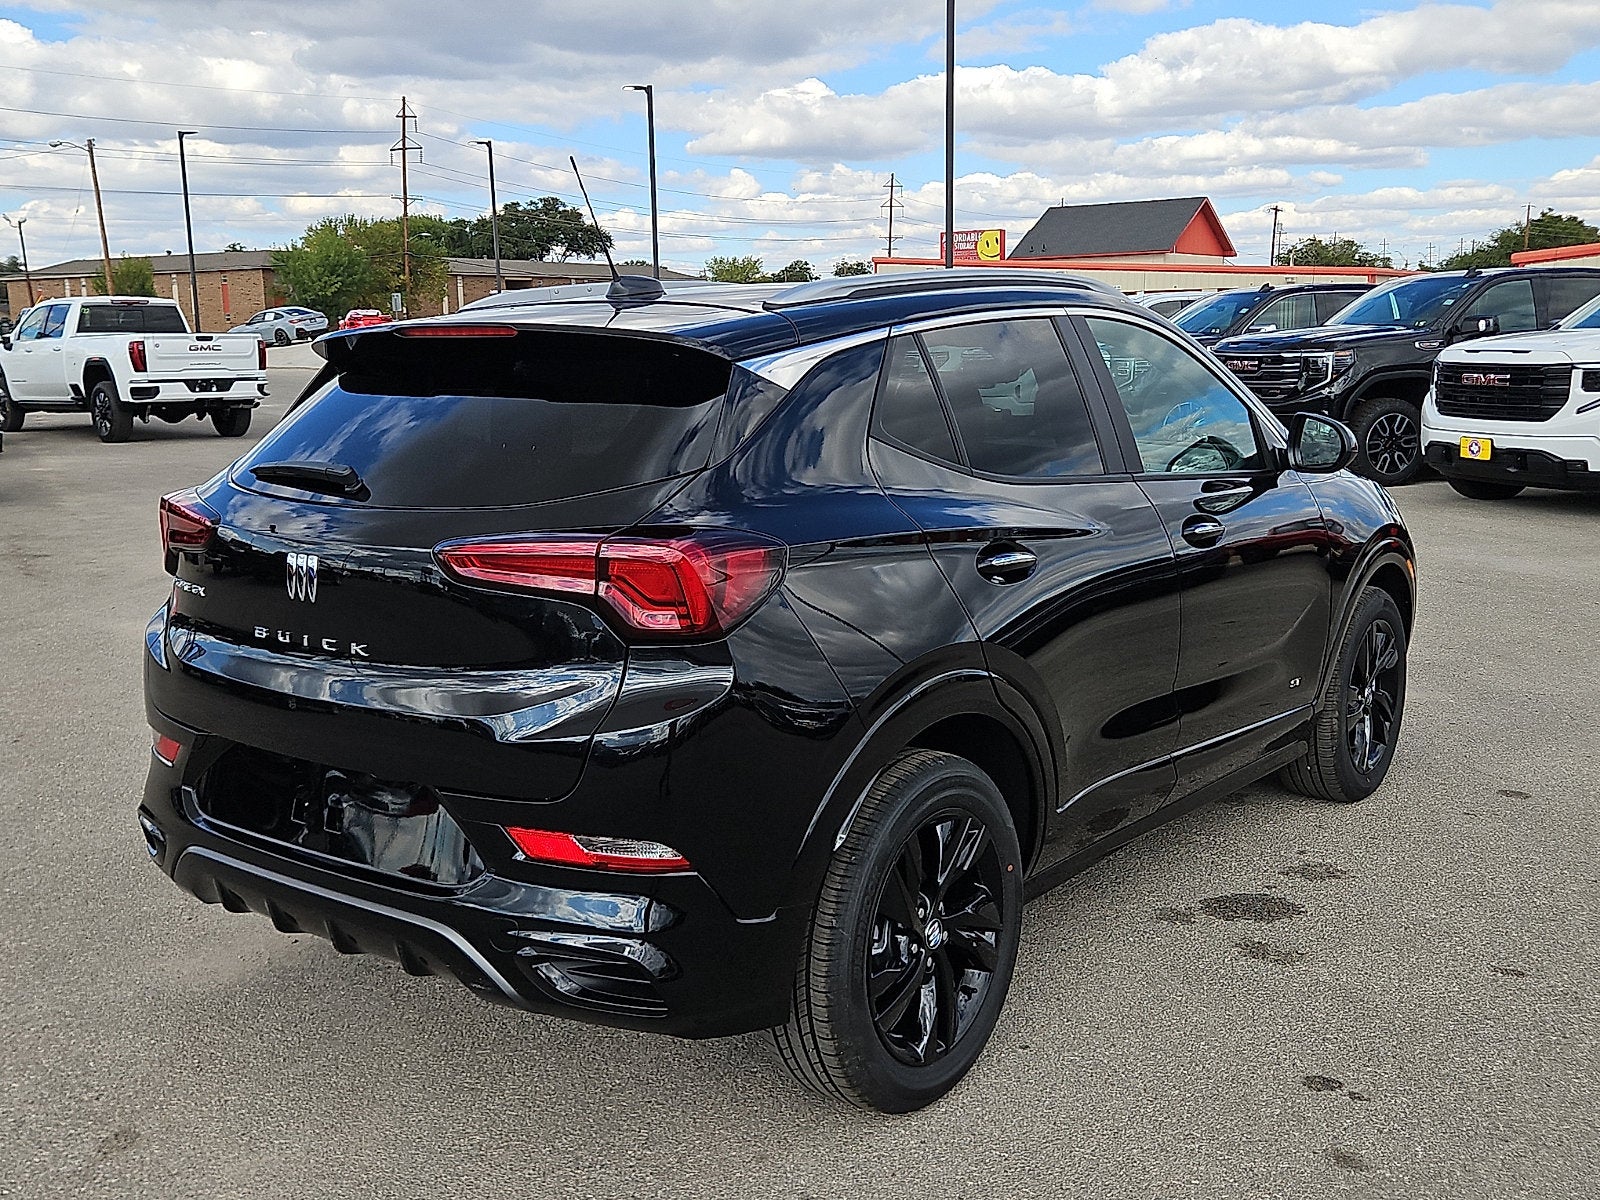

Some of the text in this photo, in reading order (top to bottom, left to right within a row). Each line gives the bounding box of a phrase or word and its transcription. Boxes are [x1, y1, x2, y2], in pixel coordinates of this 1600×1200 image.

[942, 232, 982, 242] AORDABLE
[1227, 361, 1258, 370] GMC
[1462, 374, 1510, 386] GMC
[254, 626, 370, 656] BUICK
